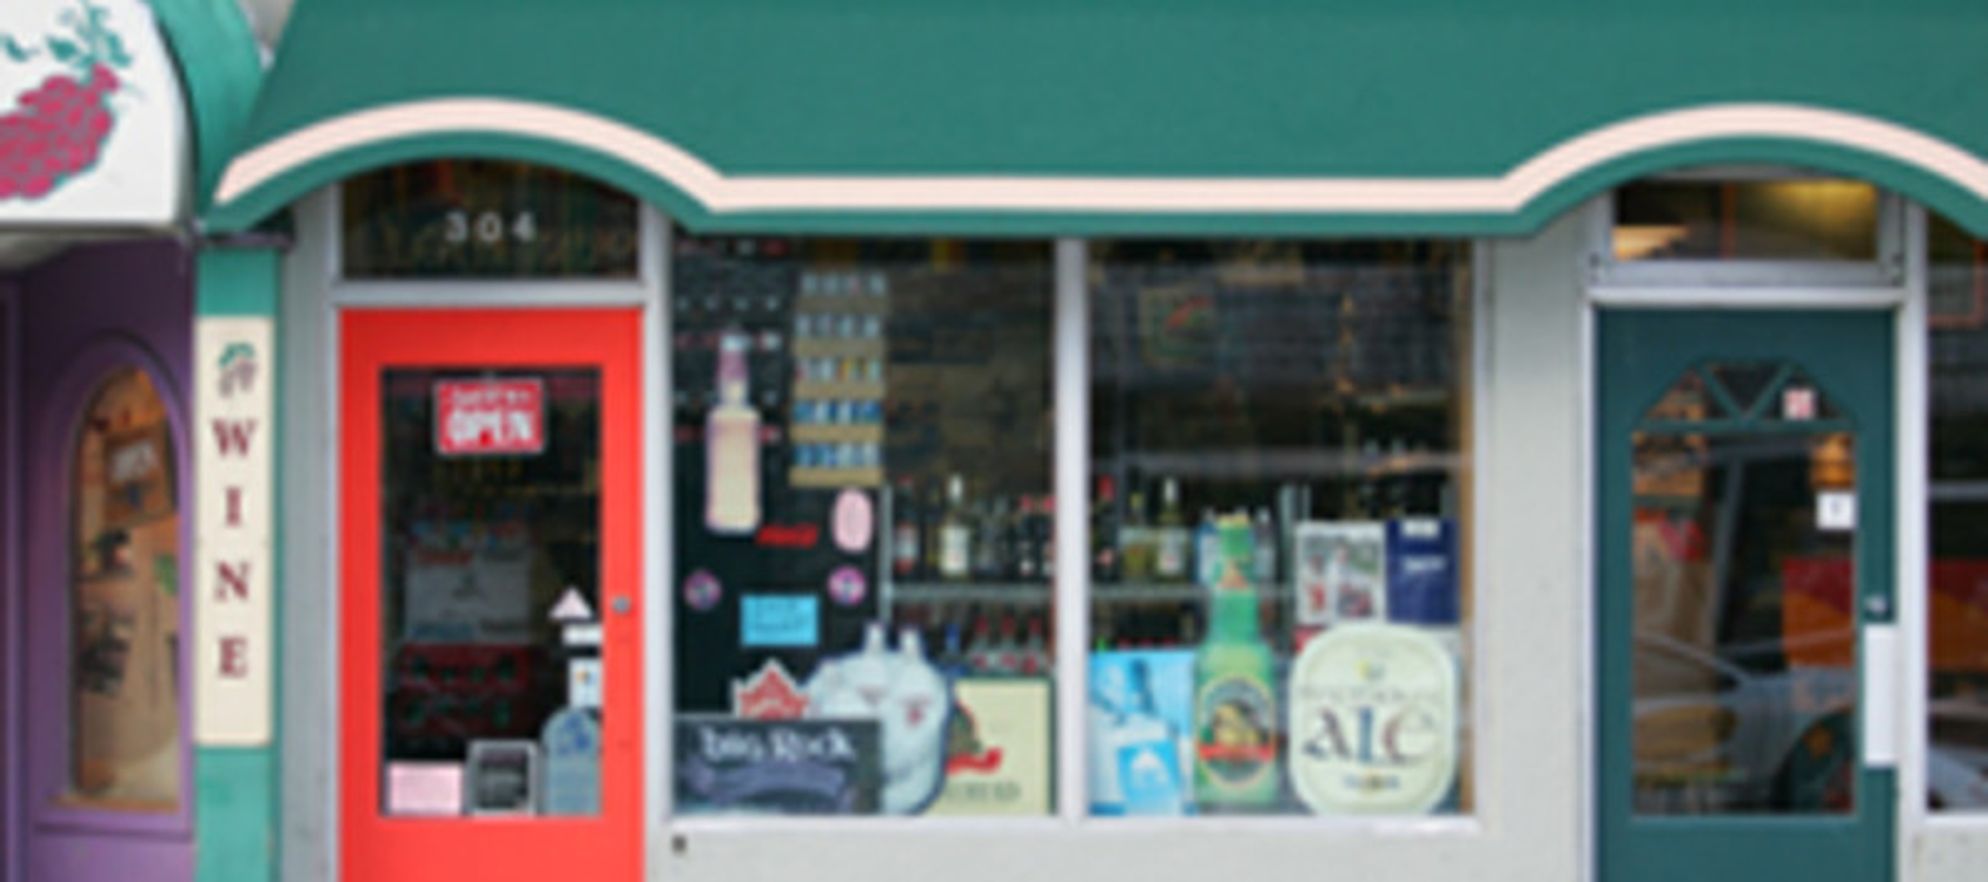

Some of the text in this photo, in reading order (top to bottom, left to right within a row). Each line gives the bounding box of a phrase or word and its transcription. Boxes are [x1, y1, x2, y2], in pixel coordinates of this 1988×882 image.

[443, 210, 538, 244] 304
[448, 411, 535, 444] OPEN
[209, 418, 258, 679] WINE
